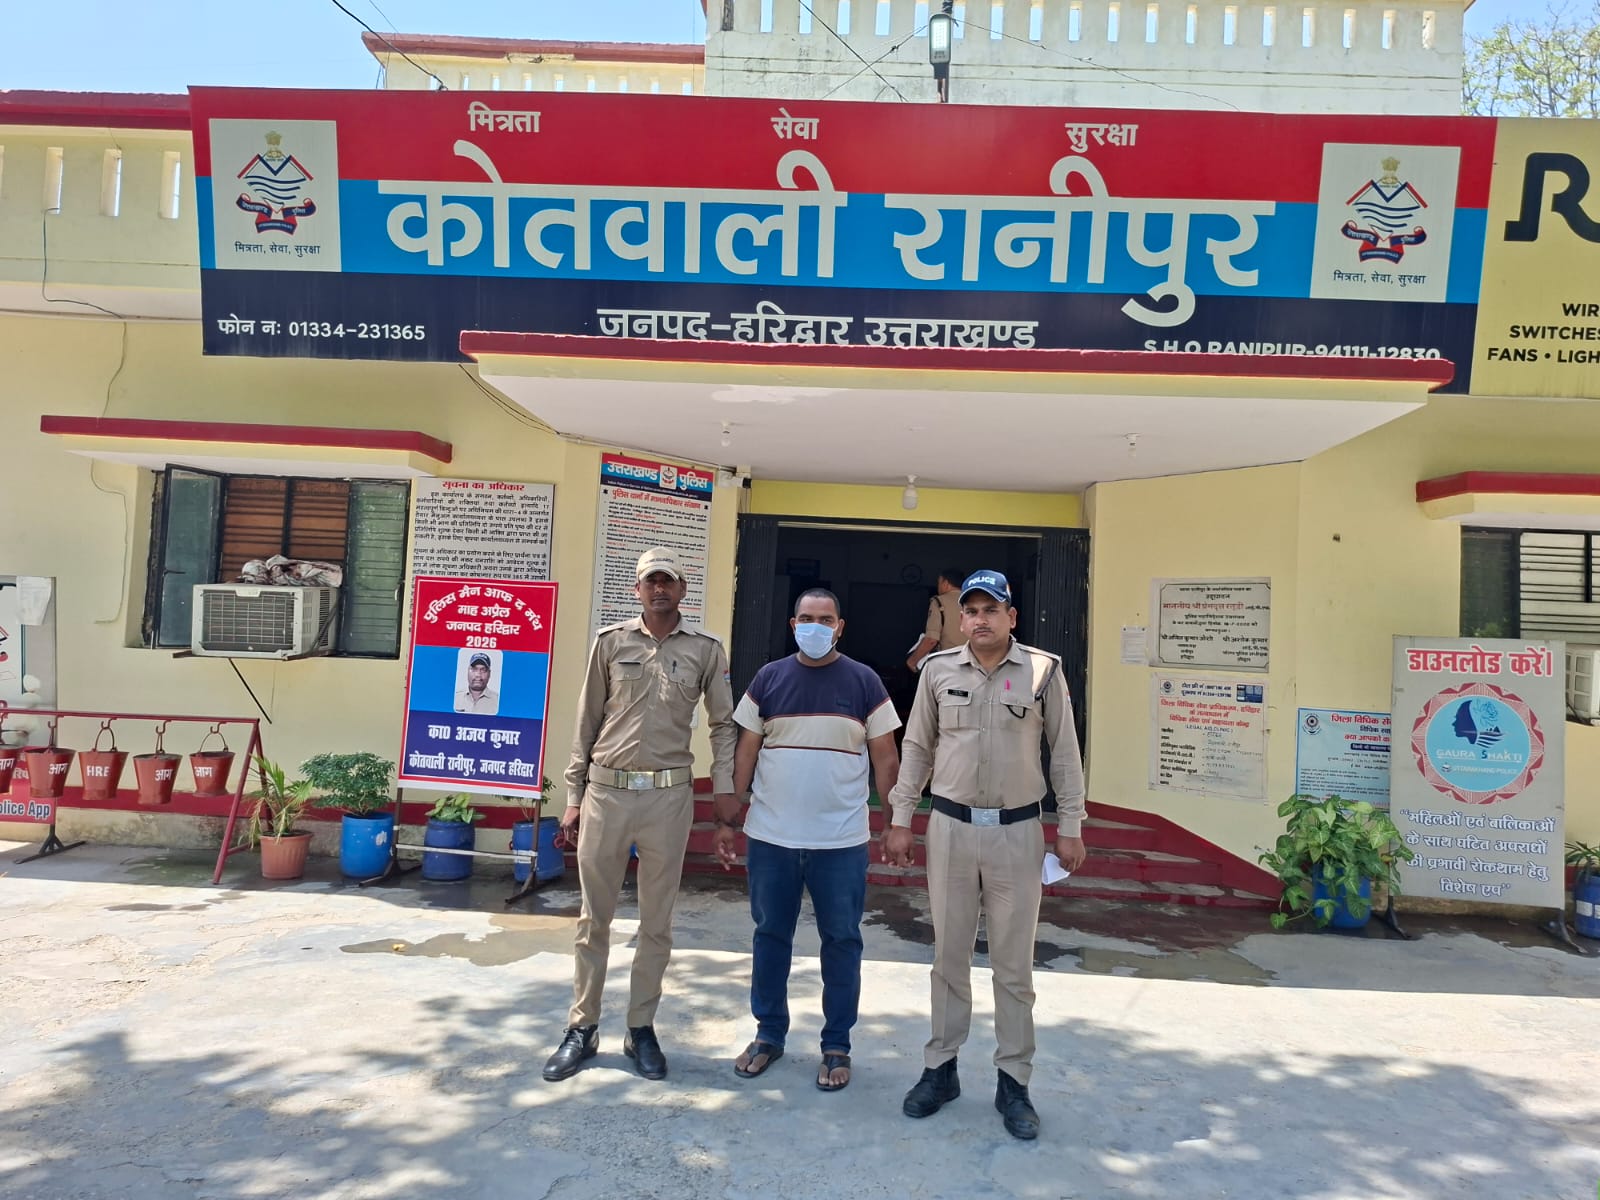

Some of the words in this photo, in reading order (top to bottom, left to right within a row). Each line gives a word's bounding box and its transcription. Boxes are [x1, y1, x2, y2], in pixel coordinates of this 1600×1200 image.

[468, 101, 541, 132] मित्रता
[771, 107, 819, 139] सेवा
[1065, 121, 1138, 153] सुरक्षा
[378, 139, 848, 277] कोतवाली
[884, 155, 1276, 327] रानीपुर
[234, 241, 266, 254] मित्रता,
[270, 242, 291, 254] सेवा,
[294, 245, 320, 258] सुरक्षा
[1333, 270, 1366, 283] मित्रता,
[1371, 271, 1394, 284] सेवा,
[1398, 274, 1426, 287] सुरक्षा
[217, 313, 255, 336] फोन
[288, 321, 426, 341] 01334-231365
[864, 316, 1039, 350] उत्तराखण्ड
[1487, 348, 1538, 362] FANS
[608, 461, 659, 480] उत्तराखण्ड
[679, 471, 709, 490] पुलिस
[442, 482, 469, 490] सूचना
[472, 482, 484, 490] का
[488, 482, 525, 490] अधिकार
[968, 576, 996, 587] POLICE
[424, 592, 457, 624] पुलिस
[458, 585, 482, 598] मैन
[484, 587, 514, 604] आफ
[514, 598, 526, 610] द
[524, 608, 543, 631] मंथ
[458, 604, 479, 616] माह
[481, 603, 511, 618] अप्रैल
[446, 620, 482, 632] जनपद
[484, 620, 522, 635] हरिद्वार
[466, 636, 497, 648] 2026
[1406, 646, 1502, 673] डाउनलोड
[1331, 714, 1352, 723] जिला
[1354, 714, 1380, 724] विधिक
[456, 726, 487, 742] अजय
[490, 728, 520, 748] कुमार
[1437, 749, 1476, 758] GAURA
[48, 763, 68, 775] आग
[86, 765, 111, 777] FIRE
[409, 750, 446, 770] कोतवाली
[448, 753, 476, 776] रानीपुर,
[480, 759, 506, 774] जनपद
[508, 758, 534, 778] हरिद्वार
[155, 769, 173, 782] आग
[28, 801, 50, 819] App
[1466, 814, 1486, 828] एवं
[1489, 814, 1556, 832] बालिकाओं
[1406, 831, 1420, 845] के
[1424, 836, 1452, 848] साथ
[1456, 834, 1490, 850] घटित
[1494, 840, 1548, 854] अपराधों
[1427, 854, 1466, 871] प्रभावी
[1470, 858, 1523, 875] रोकथाम
[1527, 862, 1549, 882] हेतु
[1440, 878, 1476, 894] विशेष
